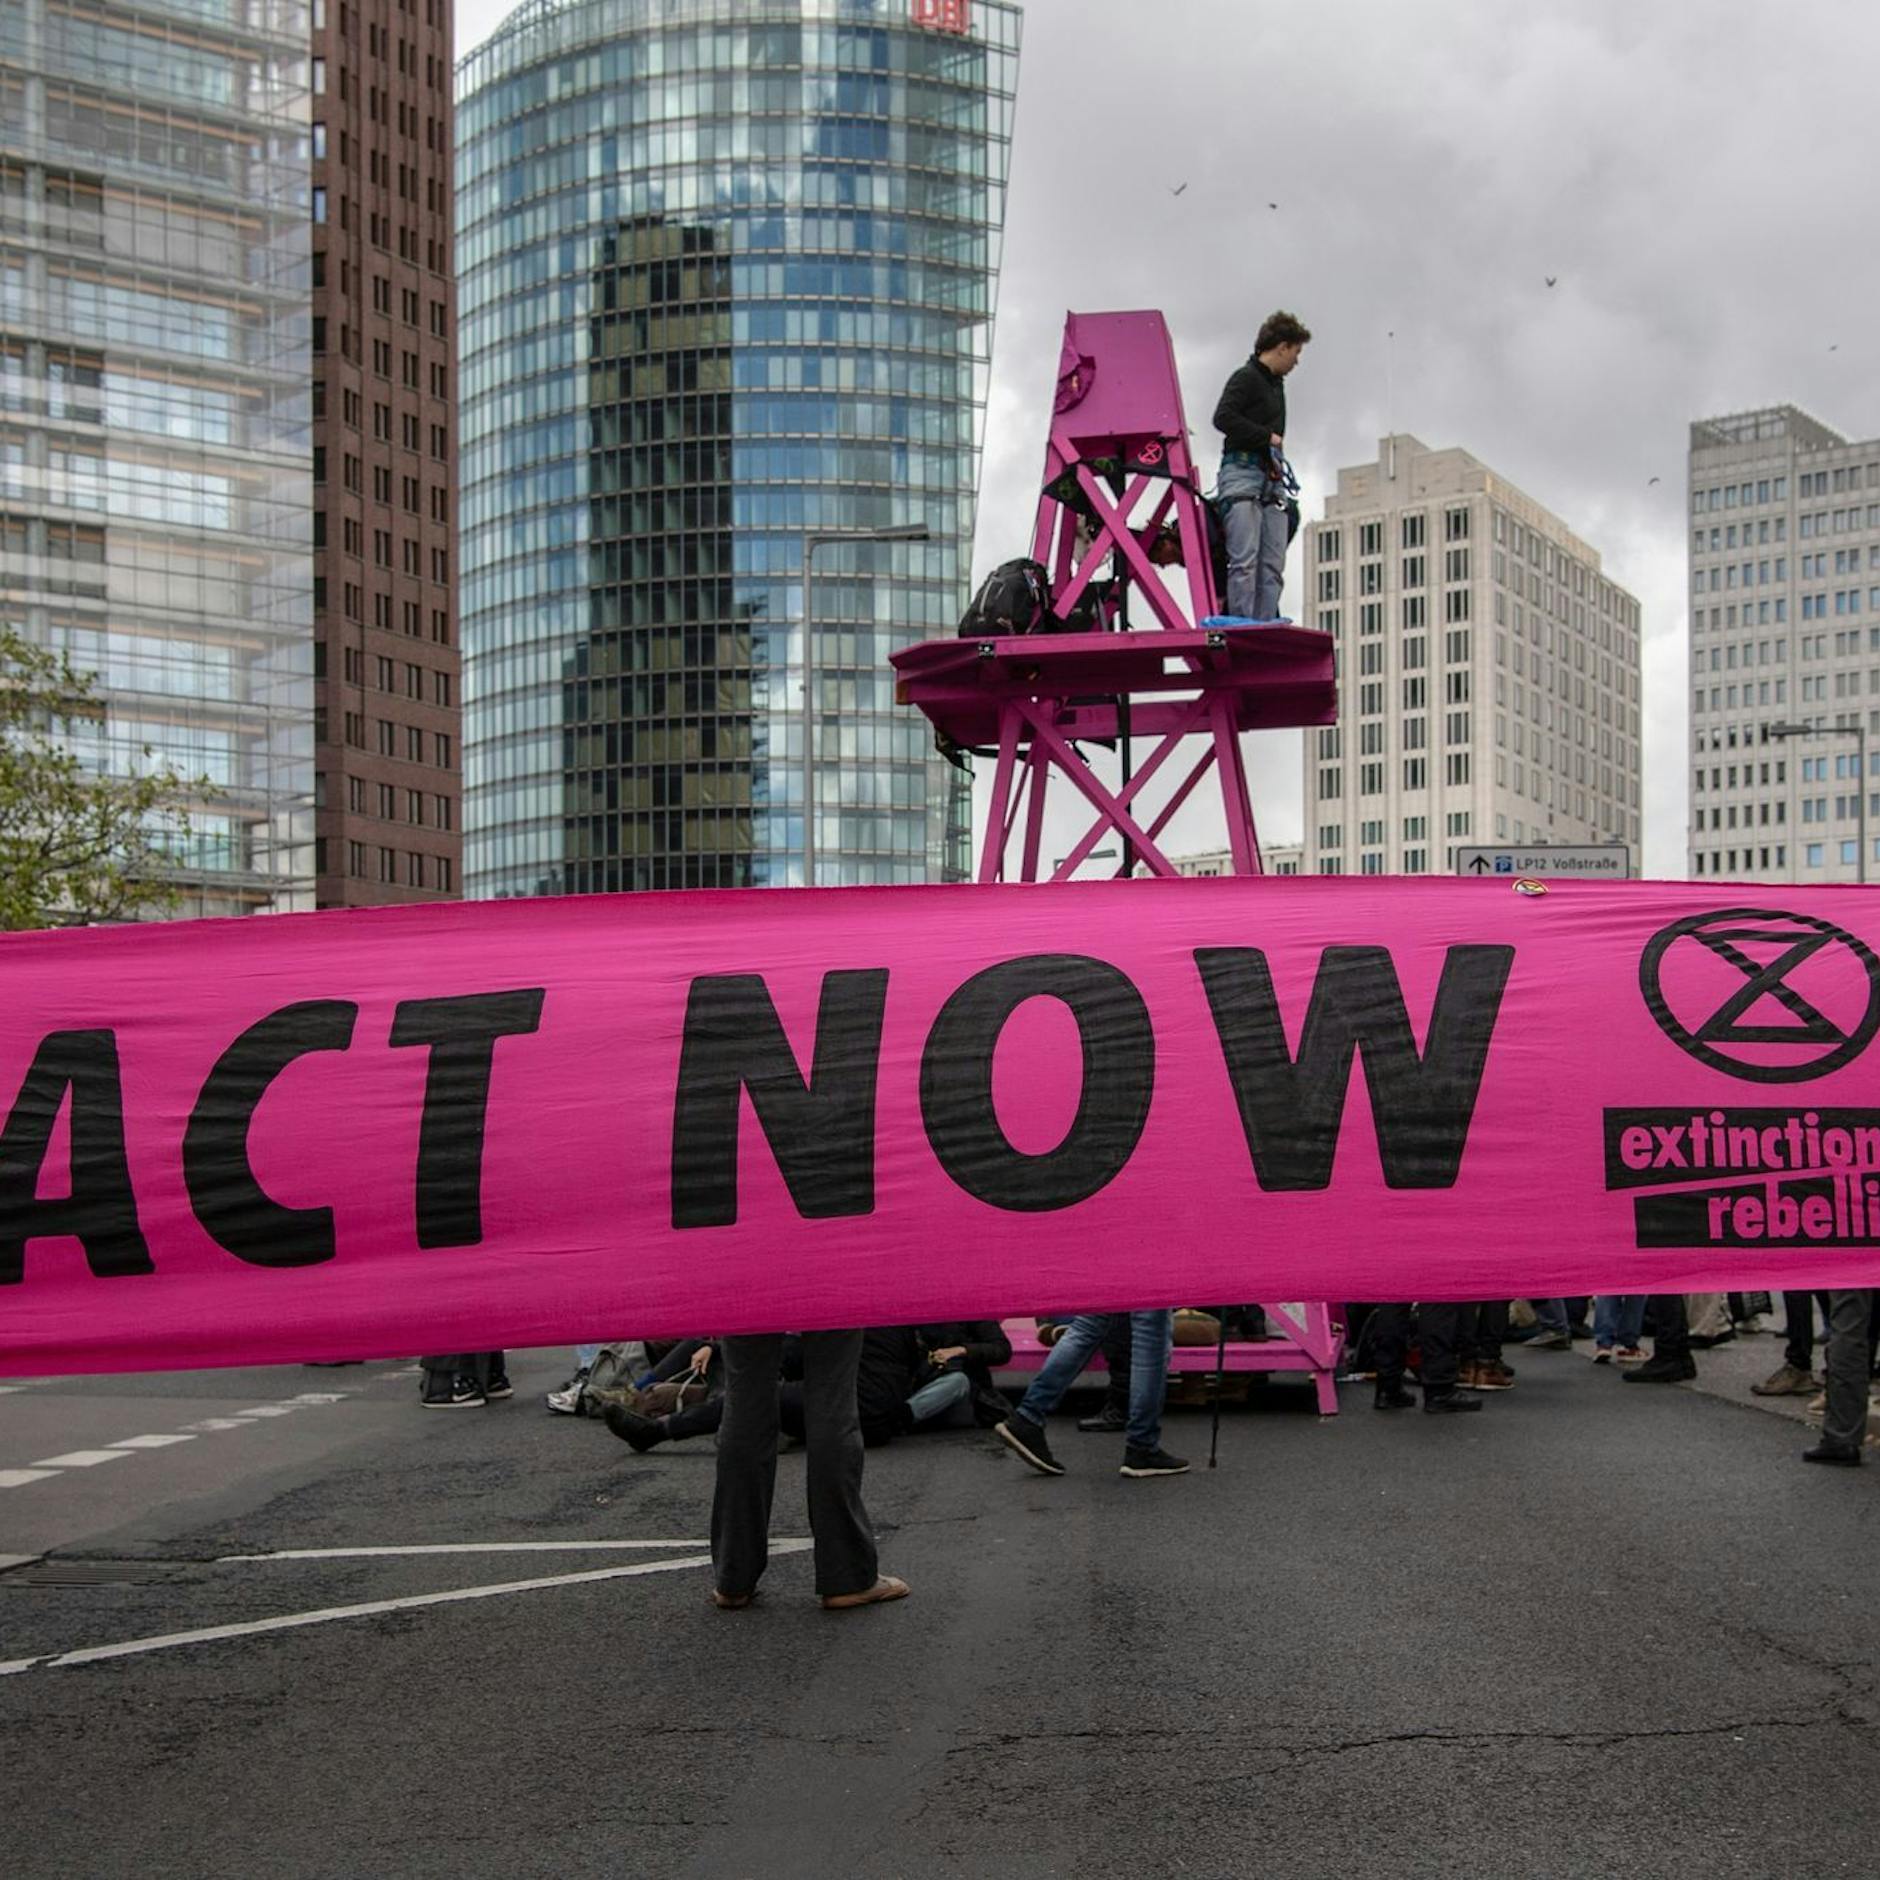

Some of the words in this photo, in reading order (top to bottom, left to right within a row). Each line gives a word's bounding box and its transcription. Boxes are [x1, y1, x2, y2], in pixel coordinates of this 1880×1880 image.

[1516, 858, 1546, 870] LP12
[1553, 858, 1618, 870] Voßstraße
[0, 988, 545, 1286] ACT
[671, 945, 1515, 1229] NOW
[1620, 1111, 1880, 1170] extinction
[1708, 1172, 1880, 1240] rebelli
